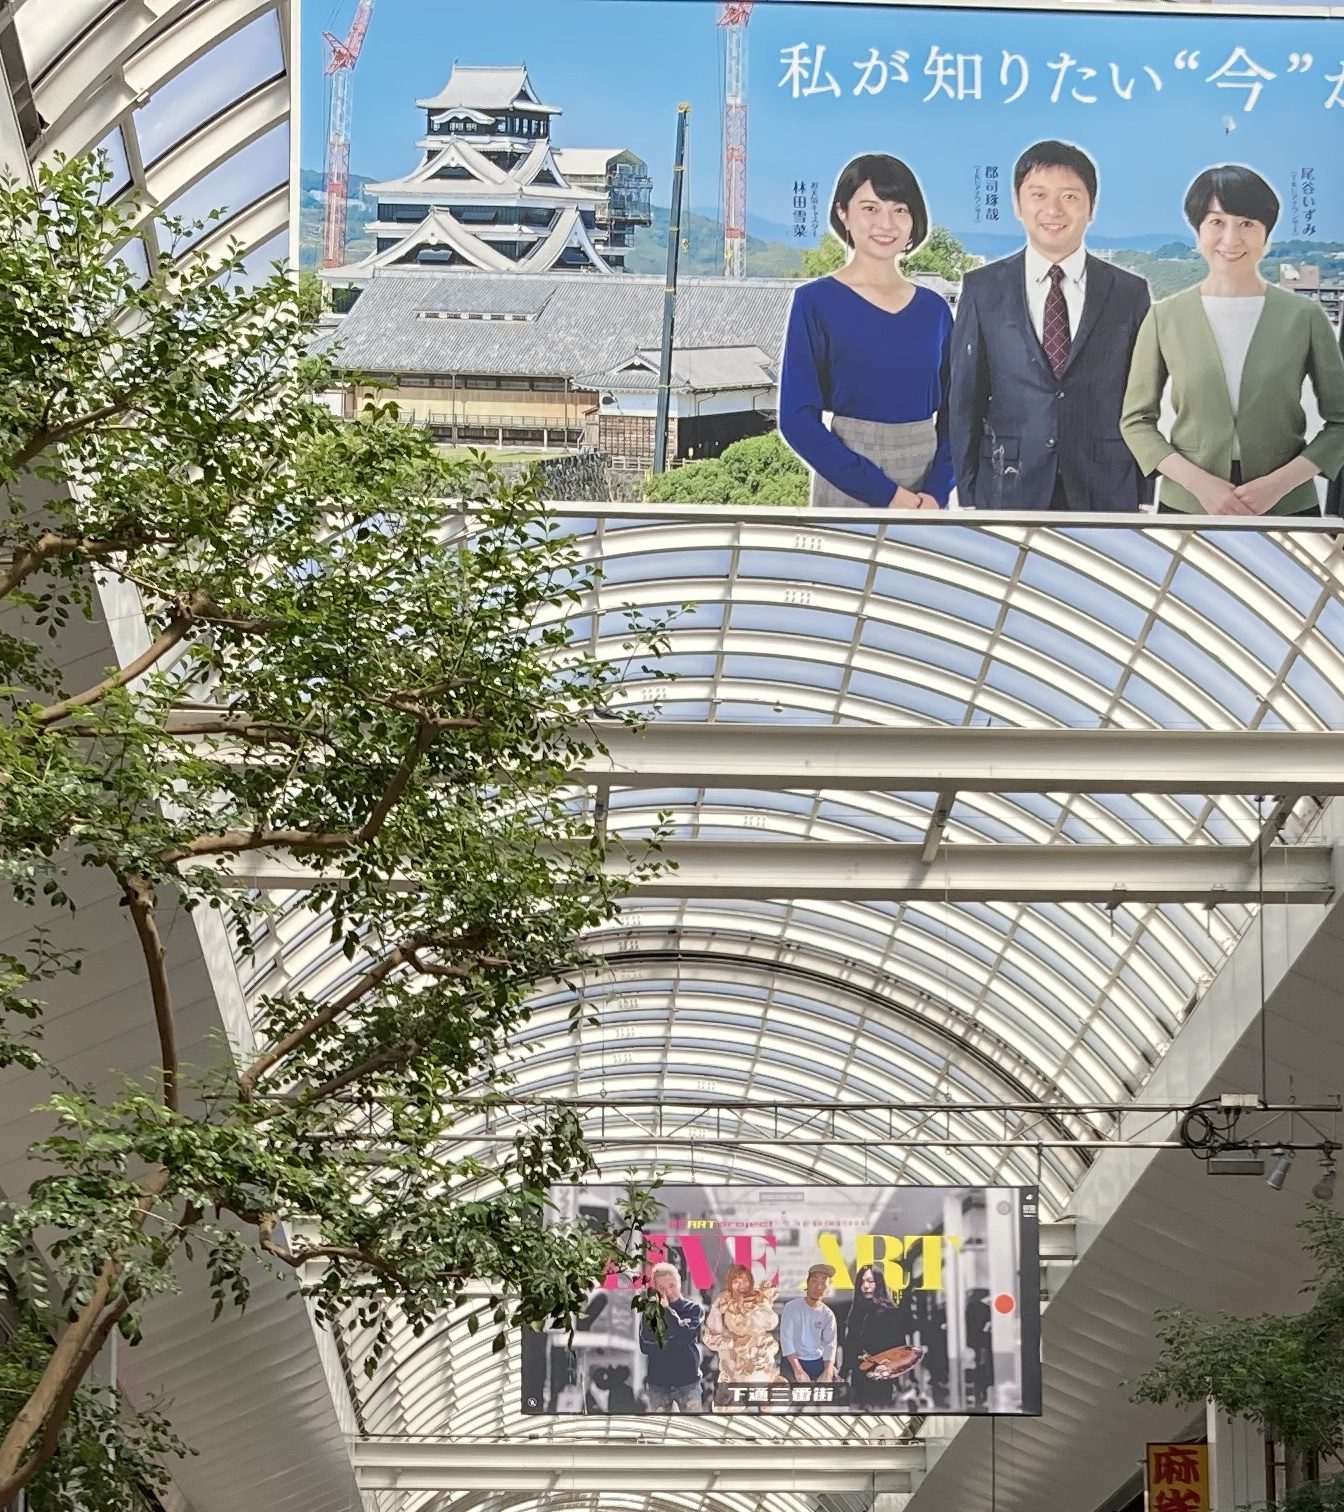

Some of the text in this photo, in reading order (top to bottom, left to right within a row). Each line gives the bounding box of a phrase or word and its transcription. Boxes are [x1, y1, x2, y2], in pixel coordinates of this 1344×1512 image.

[1301, 167, 1316, 236] 尾谷いずみ
[727, 1386, 835, 1403] 下通三番街
